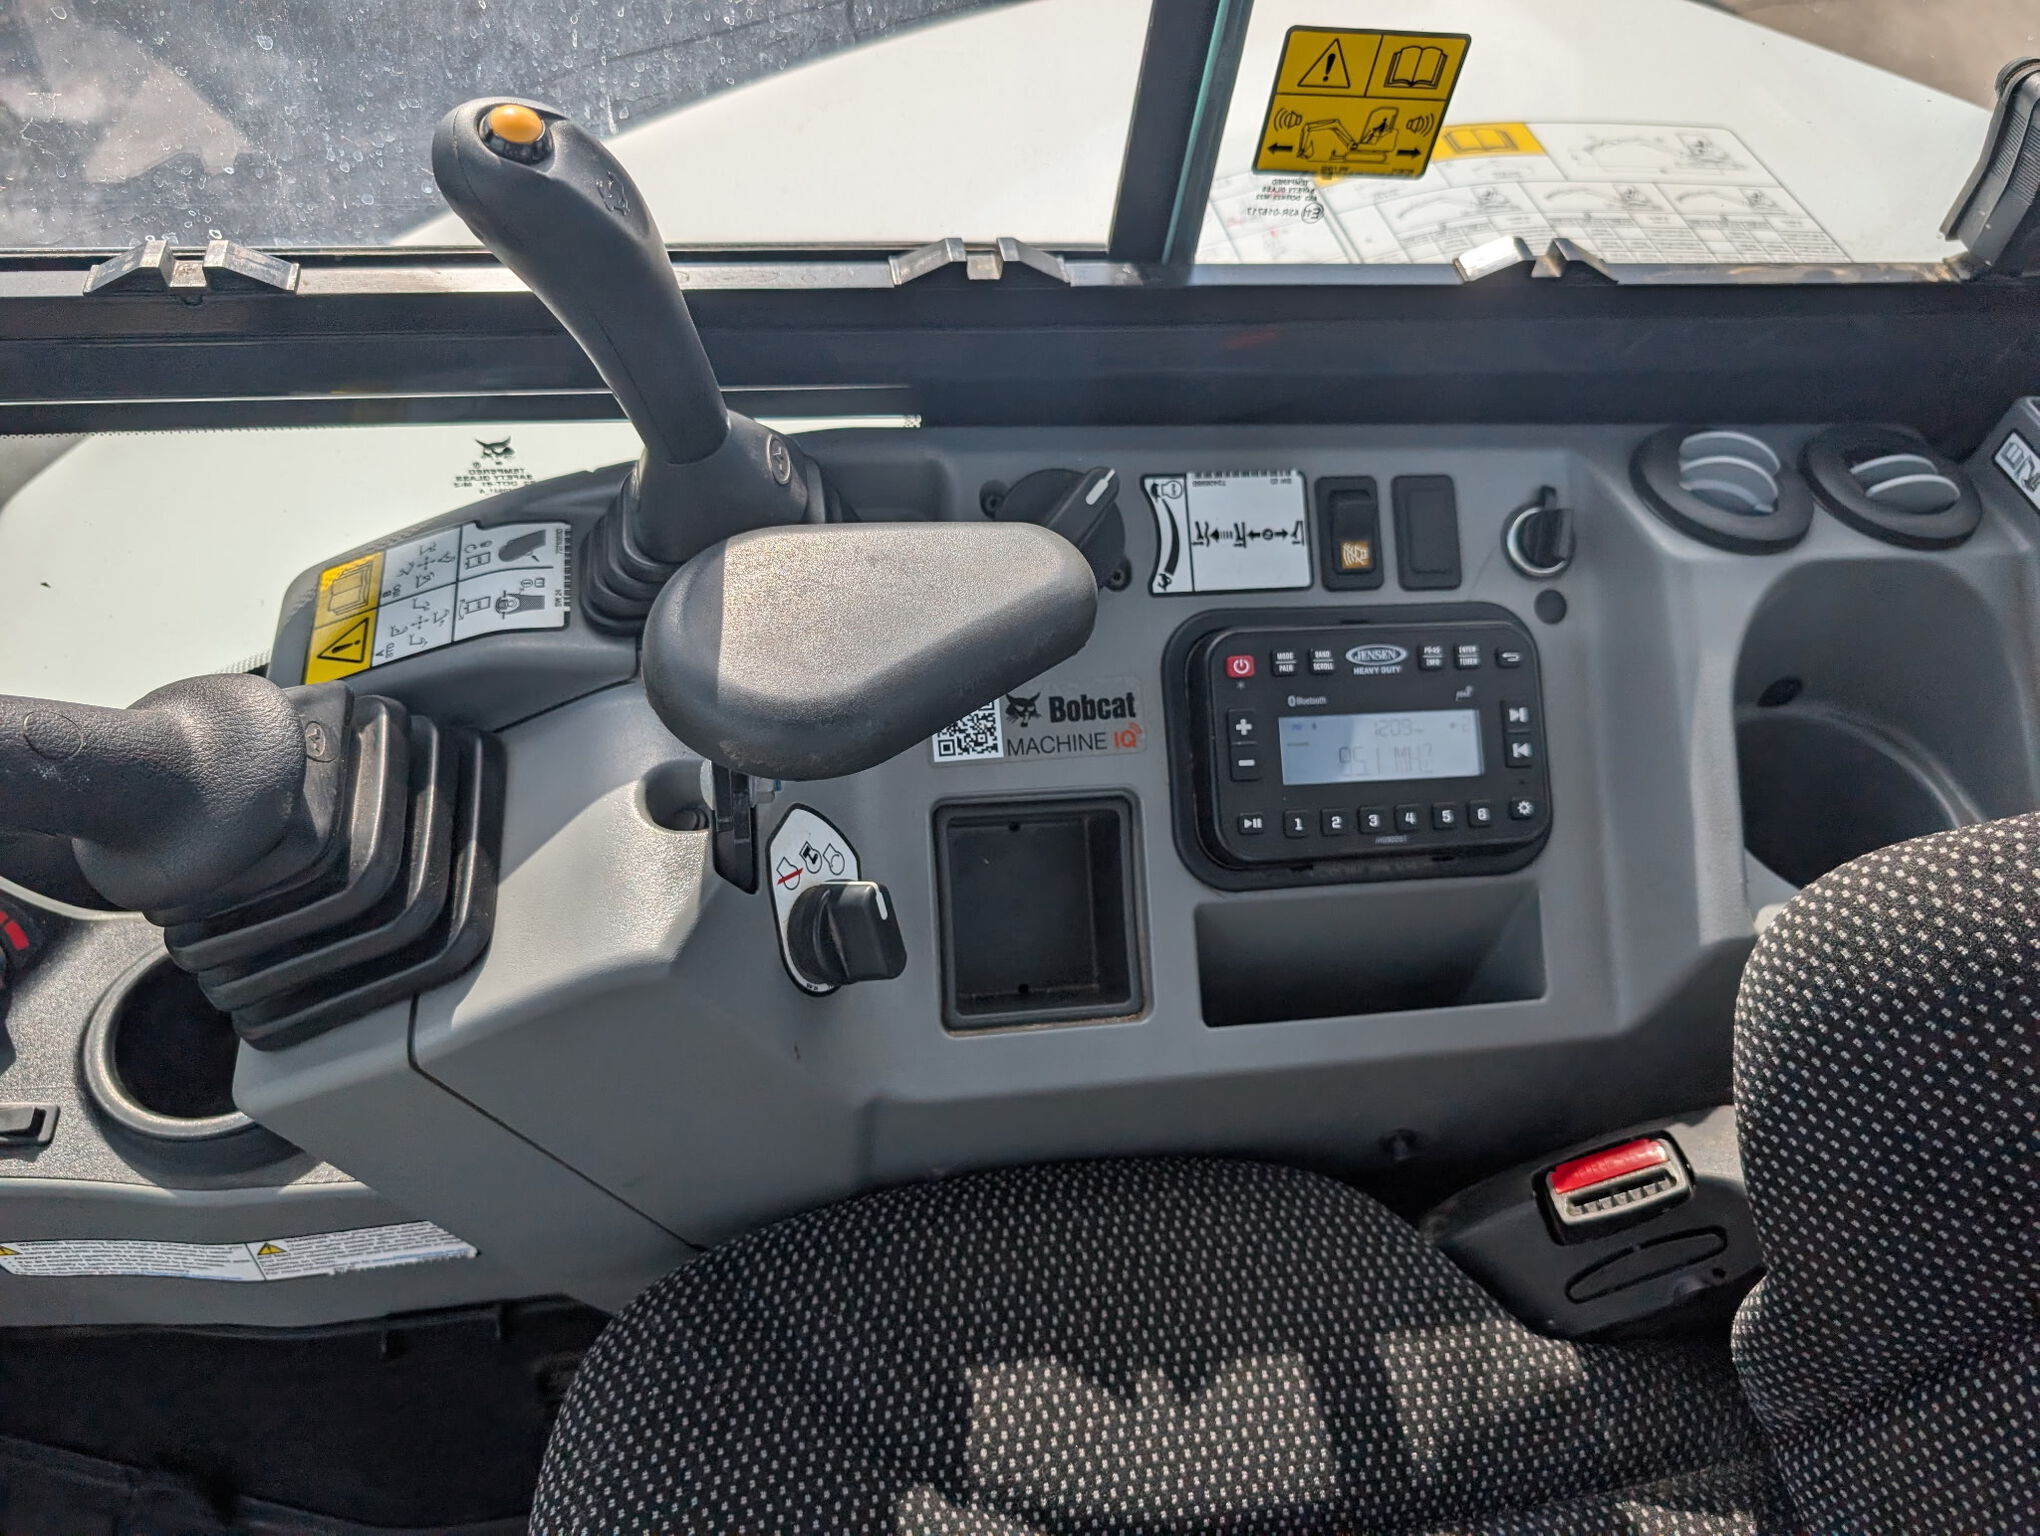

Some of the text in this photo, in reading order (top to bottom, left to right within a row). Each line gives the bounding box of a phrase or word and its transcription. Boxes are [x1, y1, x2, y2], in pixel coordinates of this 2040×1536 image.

[1276, 651, 1294, 660] MODE
[1354, 649, 1397, 661] JENSEN
[1353, 665, 1402, 675] HEAVY DUTY
[1048, 692, 1136, 723] Bobcat
[1007, 730, 1139, 756] MACHINE IQ
[1368, 814, 1381, 828] 3
[1404, 811, 1418, 825] 4
[1441, 810, 1454, 823] 5
[1476, 808, 1490, 821] 6
[1295, 817, 1303, 831] 1
[1331, 816, 1343, 829] 2
